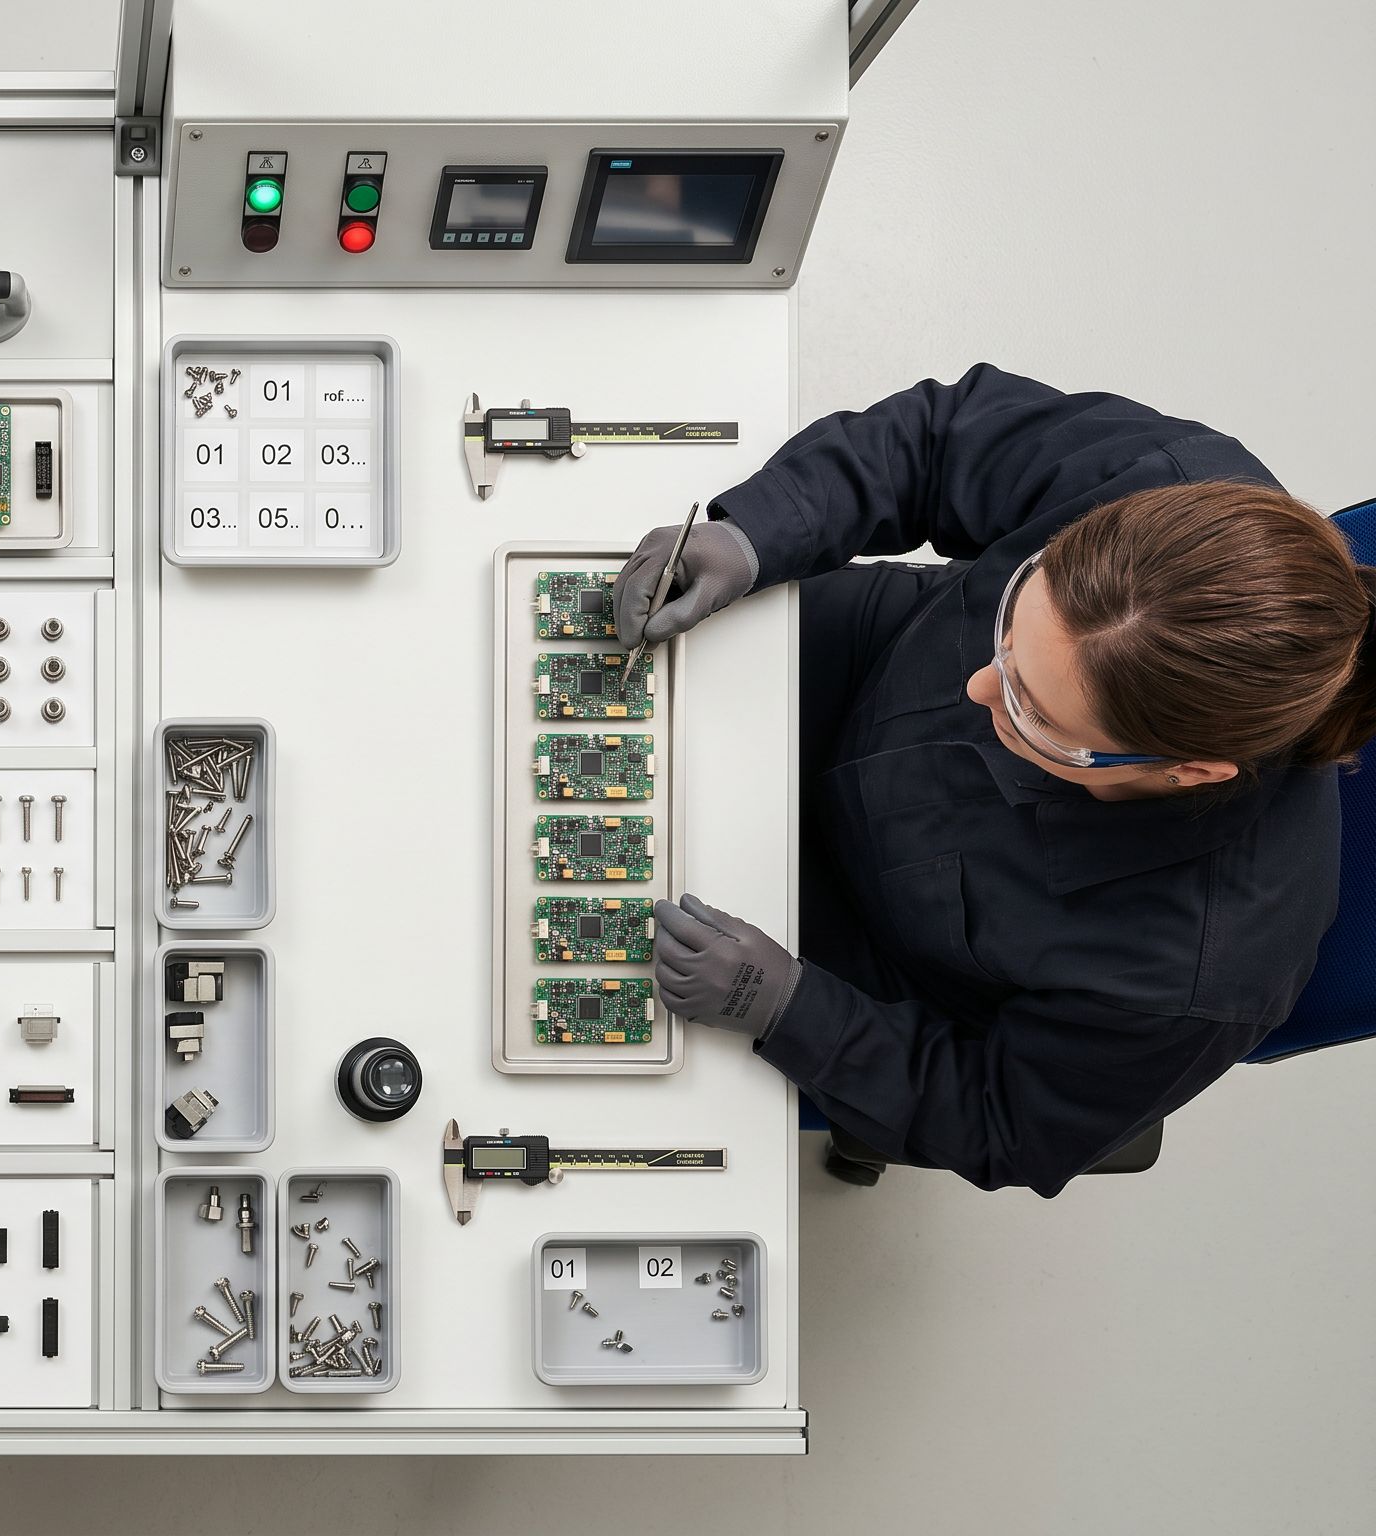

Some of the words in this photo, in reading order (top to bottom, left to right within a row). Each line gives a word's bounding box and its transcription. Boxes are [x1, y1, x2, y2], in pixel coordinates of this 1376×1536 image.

[264, 380, 289, 402] 01
[197, 443, 222, 465] 01
[262, 444, 291, 465] 02
[551, 1258, 574, 1279] 01
[647, 1257, 674, 1278] 02
